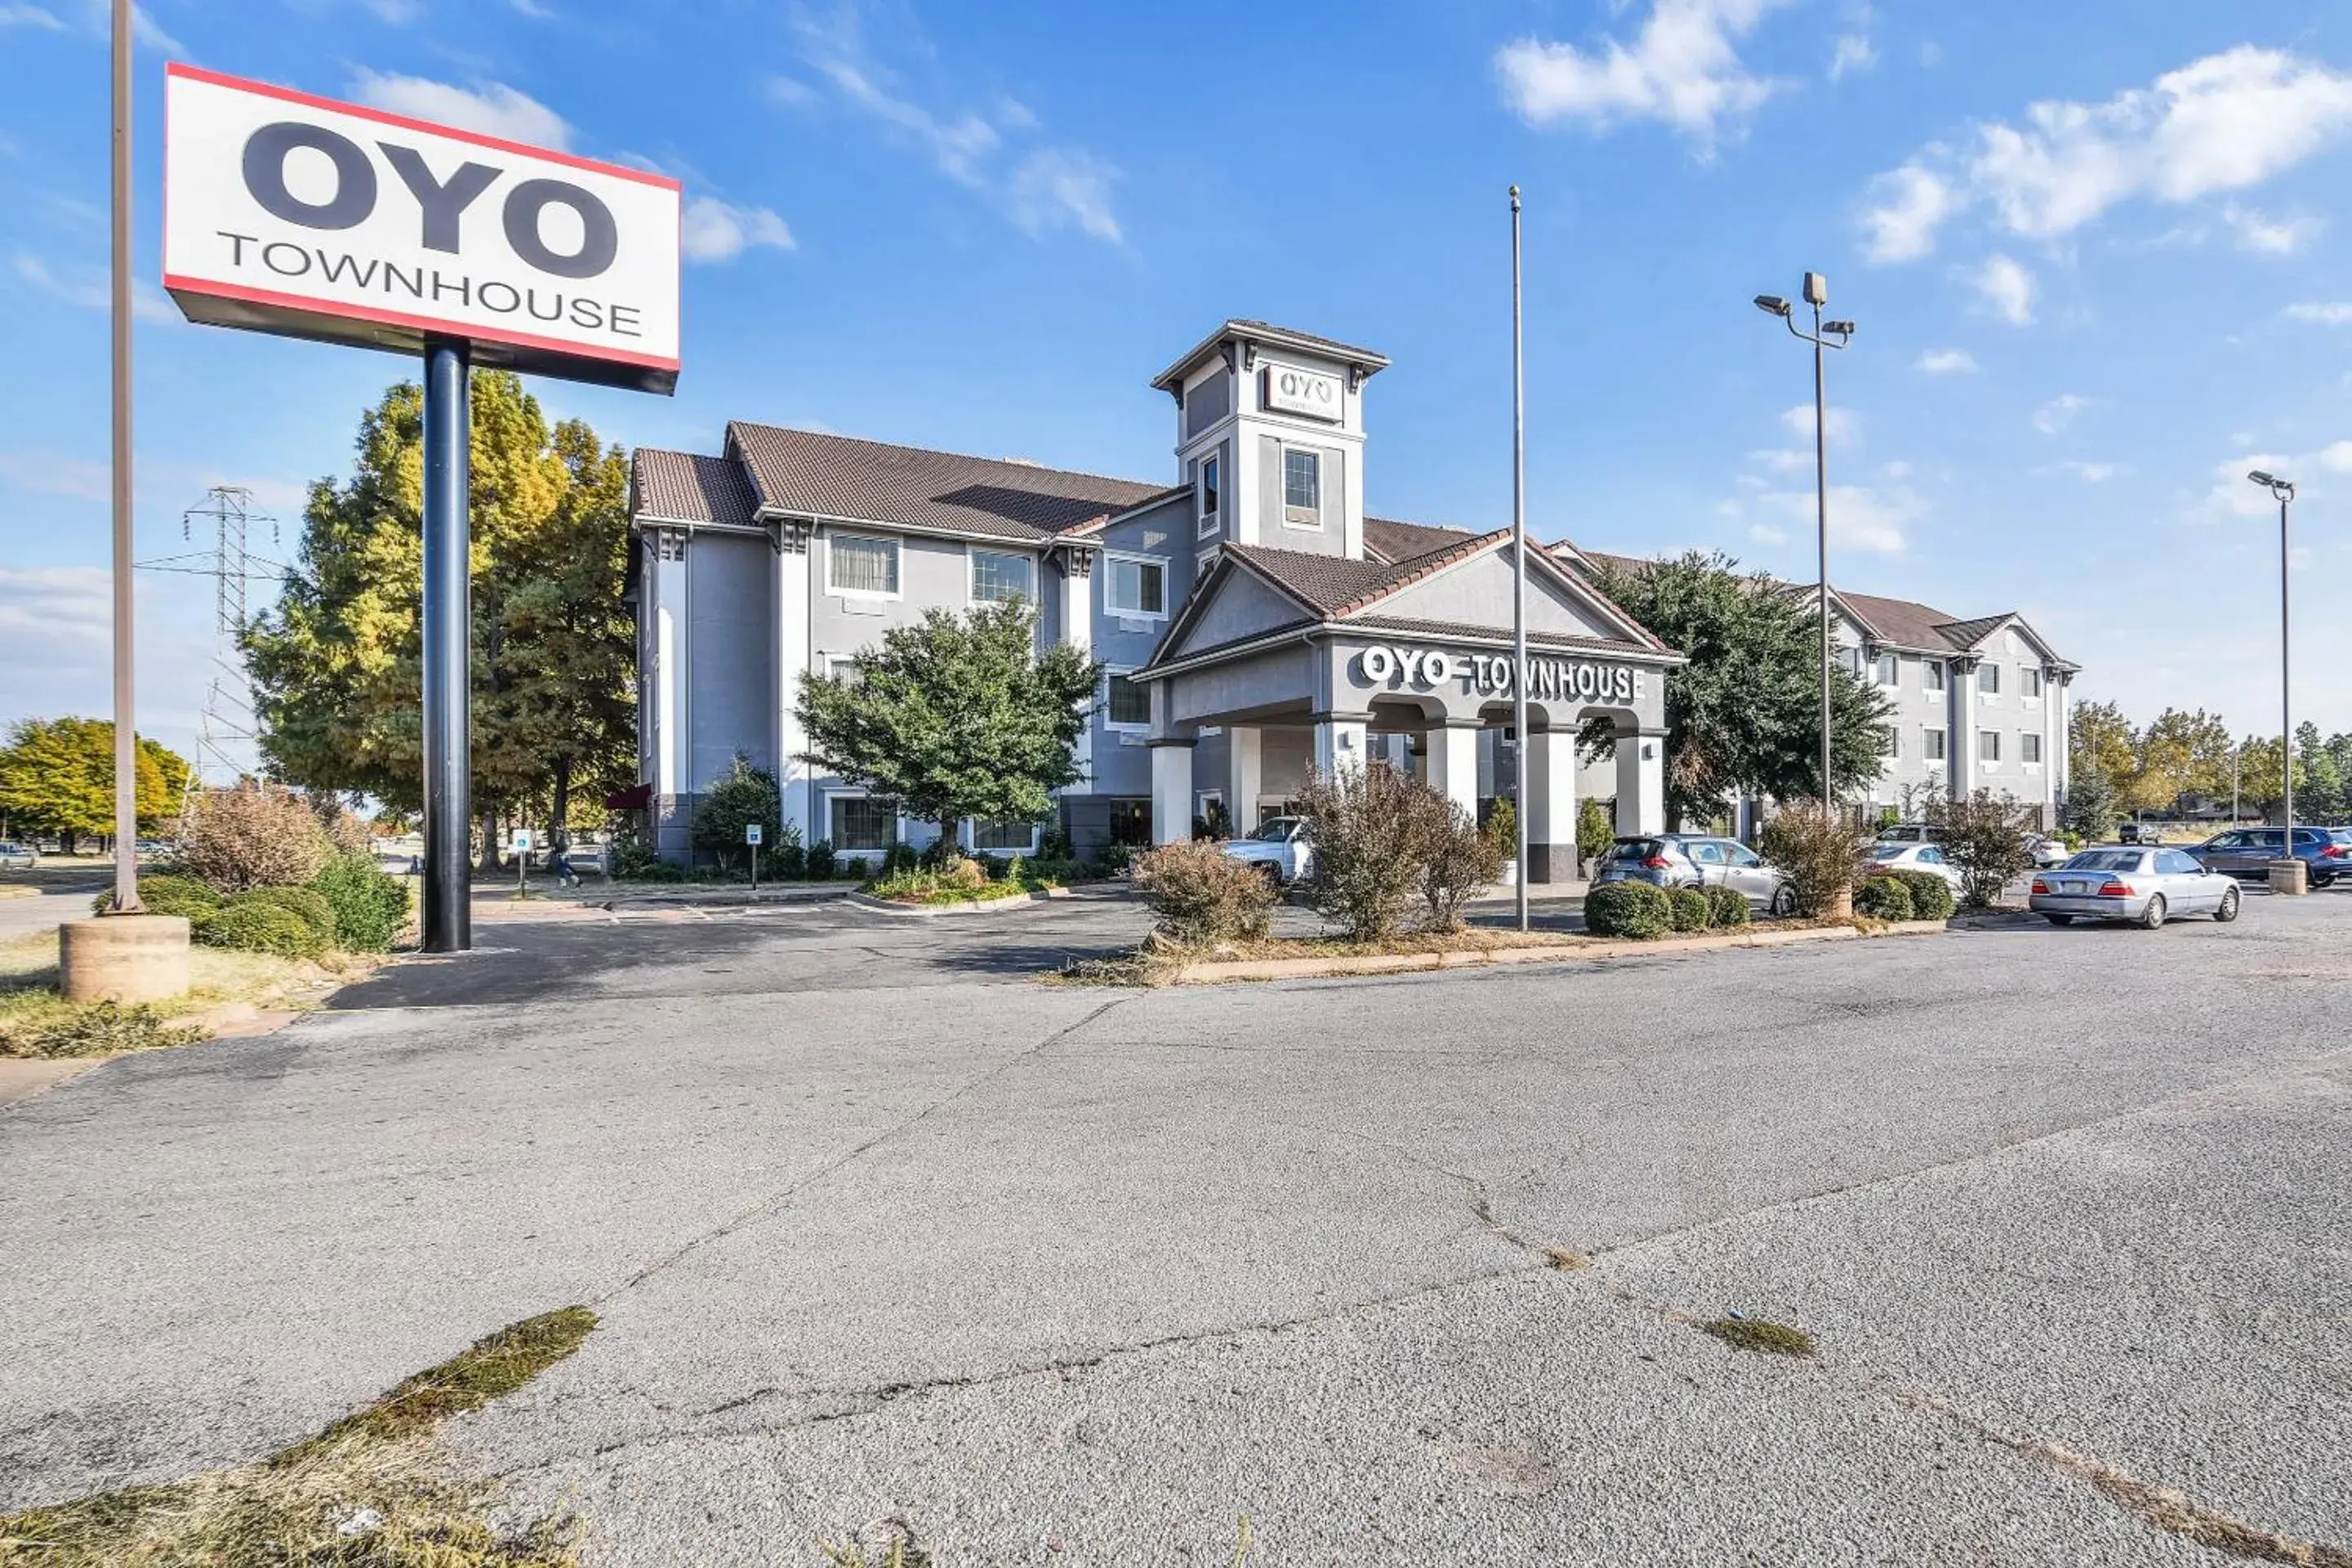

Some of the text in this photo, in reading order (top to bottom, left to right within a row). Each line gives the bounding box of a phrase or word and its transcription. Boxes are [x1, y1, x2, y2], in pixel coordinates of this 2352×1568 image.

[243, 122, 618, 278] OYO
[216, 231, 642, 336] TOWNHOUSE
[1281, 372, 1332, 403] OYO
[1363, 645, 1452, 685] OYO
